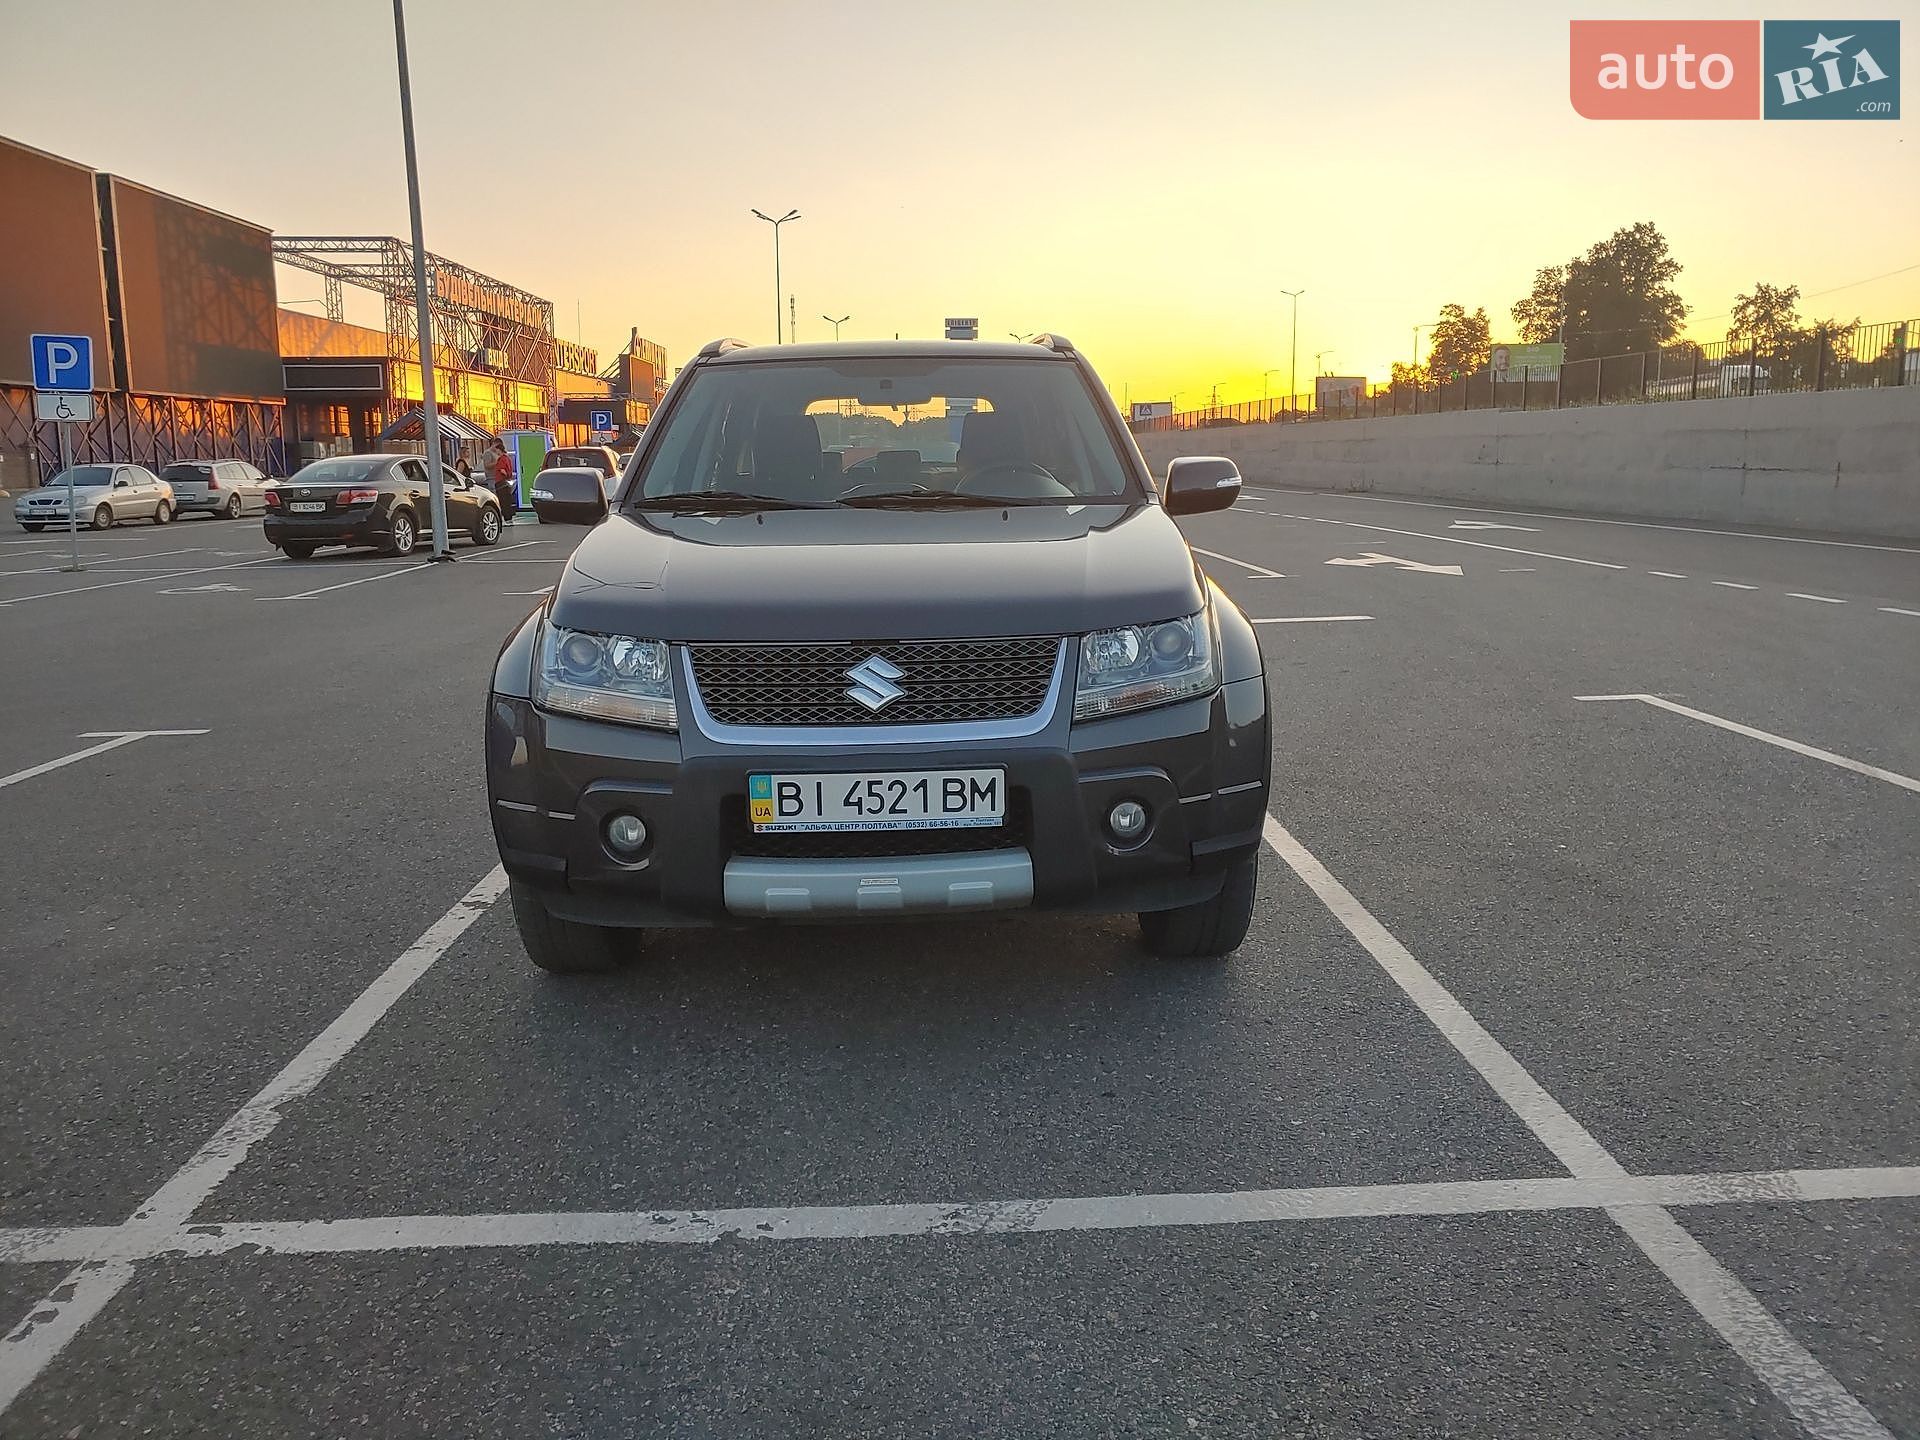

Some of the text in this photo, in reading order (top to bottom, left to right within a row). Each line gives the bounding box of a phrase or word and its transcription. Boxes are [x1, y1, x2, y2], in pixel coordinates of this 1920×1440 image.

[437, 270, 542, 330] БУДІВЕЛЬНІ МАТЕРІАЛИ
[46, 341, 78, 384] P
[595, 413, 607, 430] P
[777, 777, 997, 817] BI 4521 BM
[755, 807, 771, 817] UA
[834, 823, 859, 831] ЦЕНТР
[905, 821, 927, 829] (0532)
